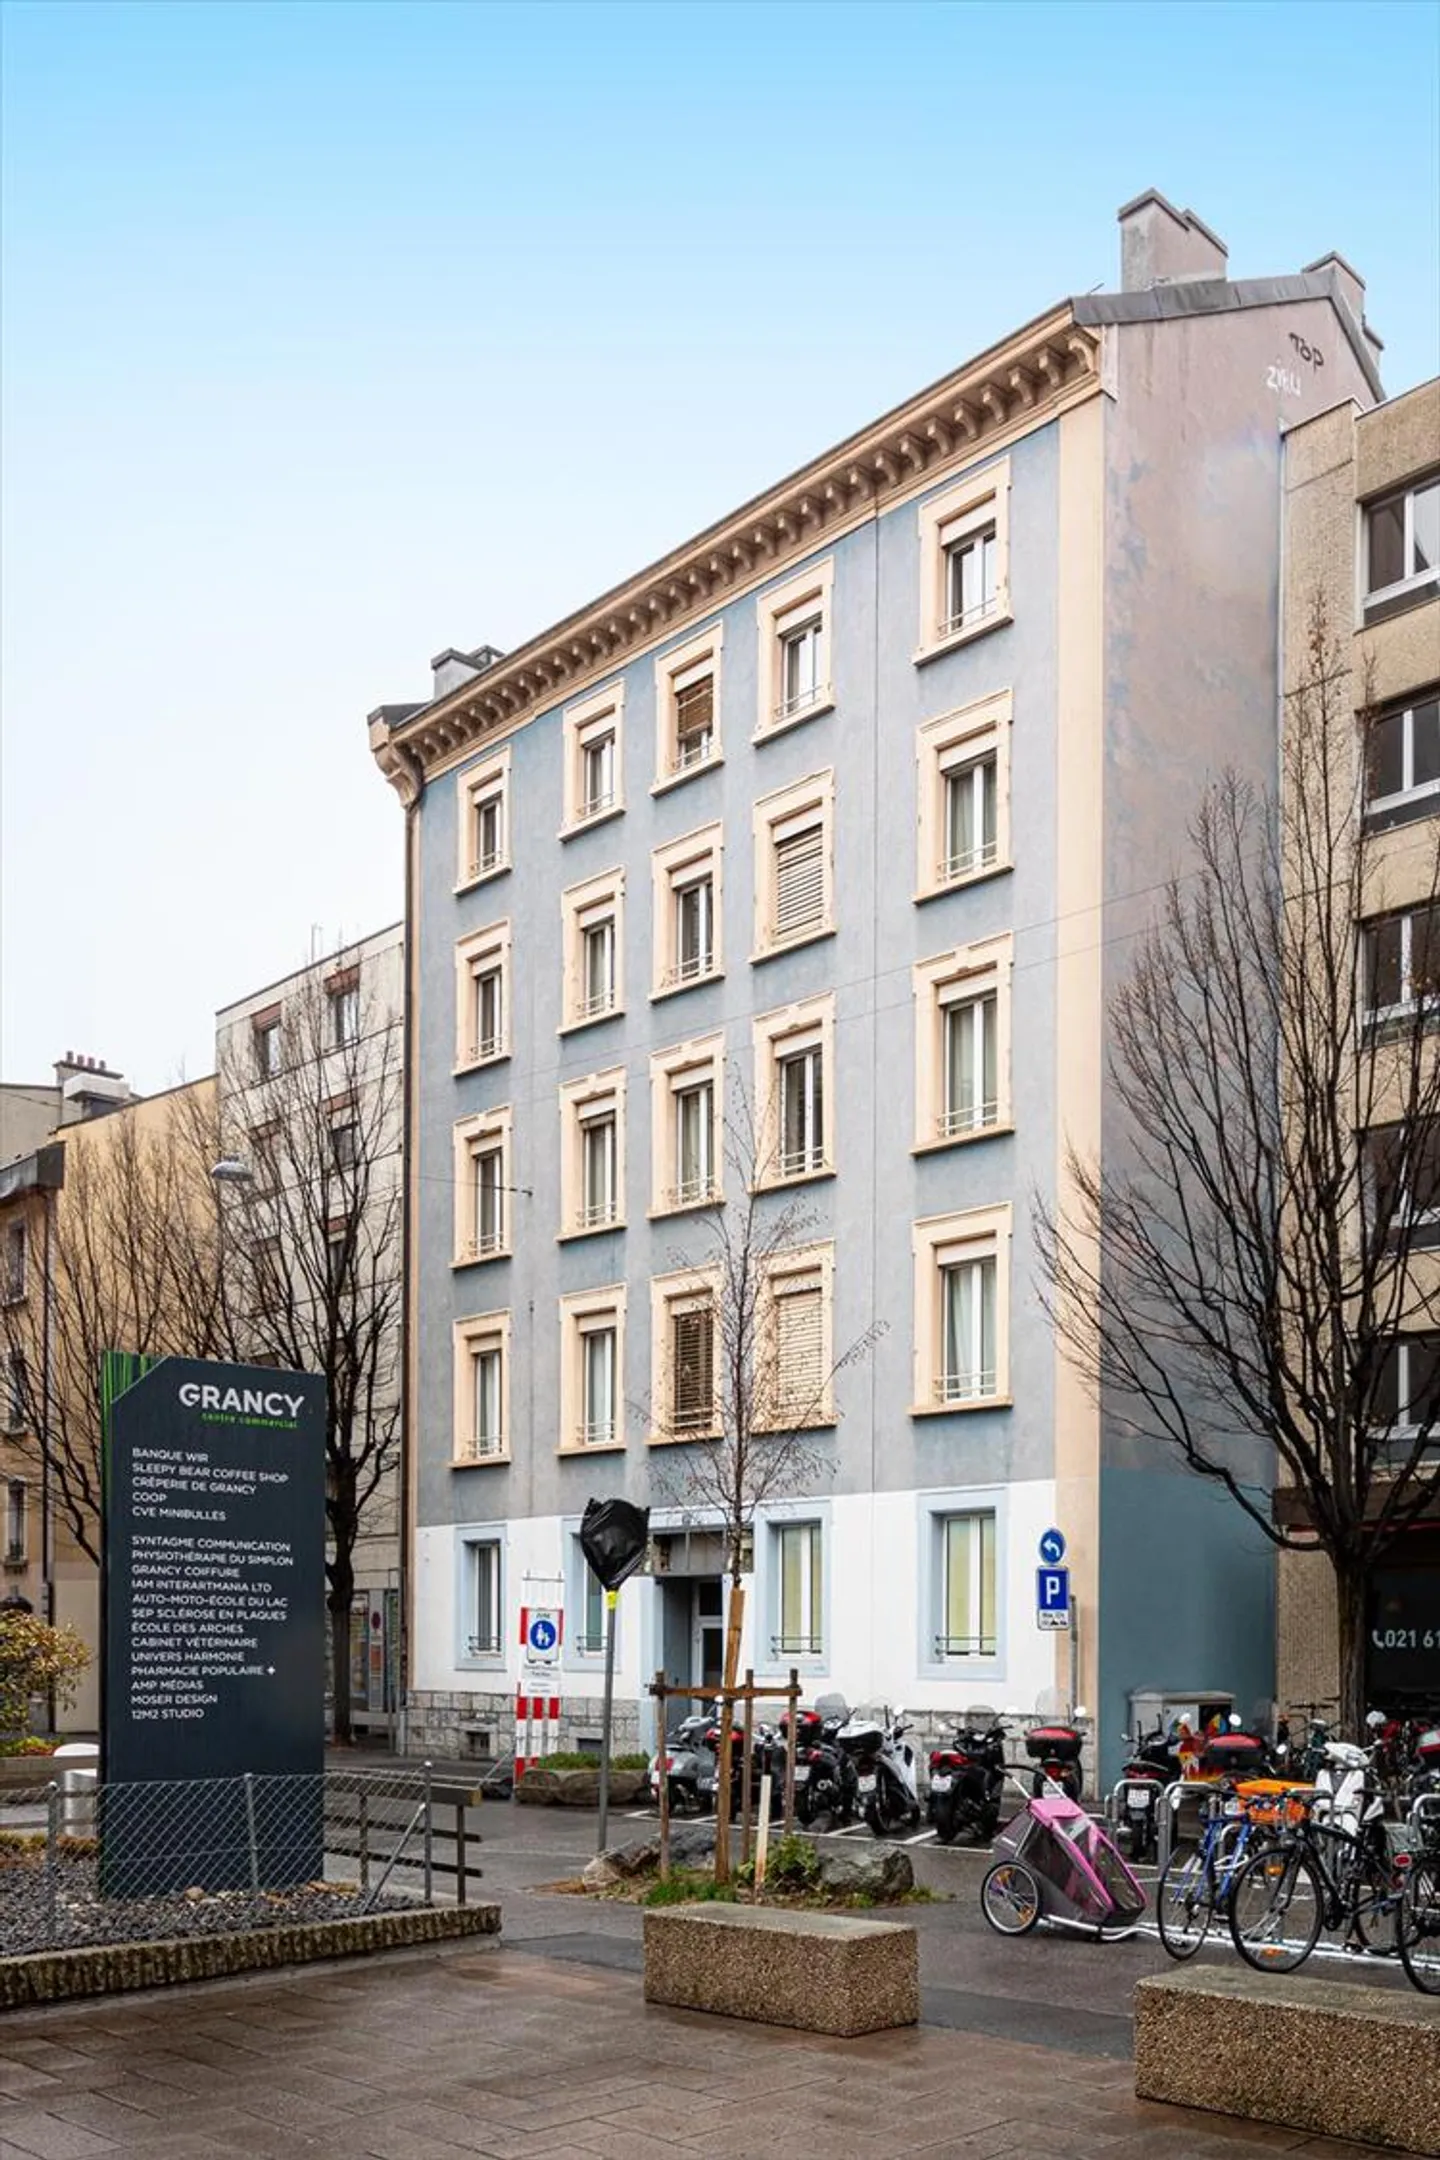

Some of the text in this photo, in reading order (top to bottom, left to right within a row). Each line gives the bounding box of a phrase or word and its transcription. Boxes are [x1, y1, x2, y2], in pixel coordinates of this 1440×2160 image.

[179, 1383, 304, 1417] GRANCY
[133, 1448, 209, 1461] BANQUE WIR
[132, 1463, 288, 1483] SLEEPY BEAR COFFEE SHOP
[192, 1481, 206, 1491] DE
[210, 1482, 256, 1494] GRANCY
[132, 1492, 167, 1502] COOP
[132, 1507, 226, 1521] CVE MINIBULLES
[132, 1536, 291, 1552] SYNTAGME COMMUNICATION
[132, 1550, 294, 1566] PHYSIOTHÉRAPIE DU SIMPLON
[132, 1565, 240, 1578] GRANCY COIFFURE
[132, 1580, 272, 1592] IAM INTERARTMANIA LTD
[1046, 1576, 1060, 1605] P
[132, 1594, 289, 1607] AUTO-MOTO-ÉCOLE DU LAC
[132, 1608, 287, 1621] SEP SCLÉROSE EN PLAQUES
[132, 1622, 244, 1634] ÉCOLE DES ARCHES
[132, 1637, 258, 1648] CABINET VÉTÉRINAIRE
[1385, 1629, 1416, 1648] 021
[132, 1652, 245, 1662] UNIVERS HARMONIE
[132, 1666, 264, 1676] PHARMACIE POPULAIRE
[132, 1679, 204, 1690] AMP MÉDIAS
[132, 1694, 218, 1705] MOSER DESIGN
[132, 1708, 204, 1719] 12M2 STUDIO
